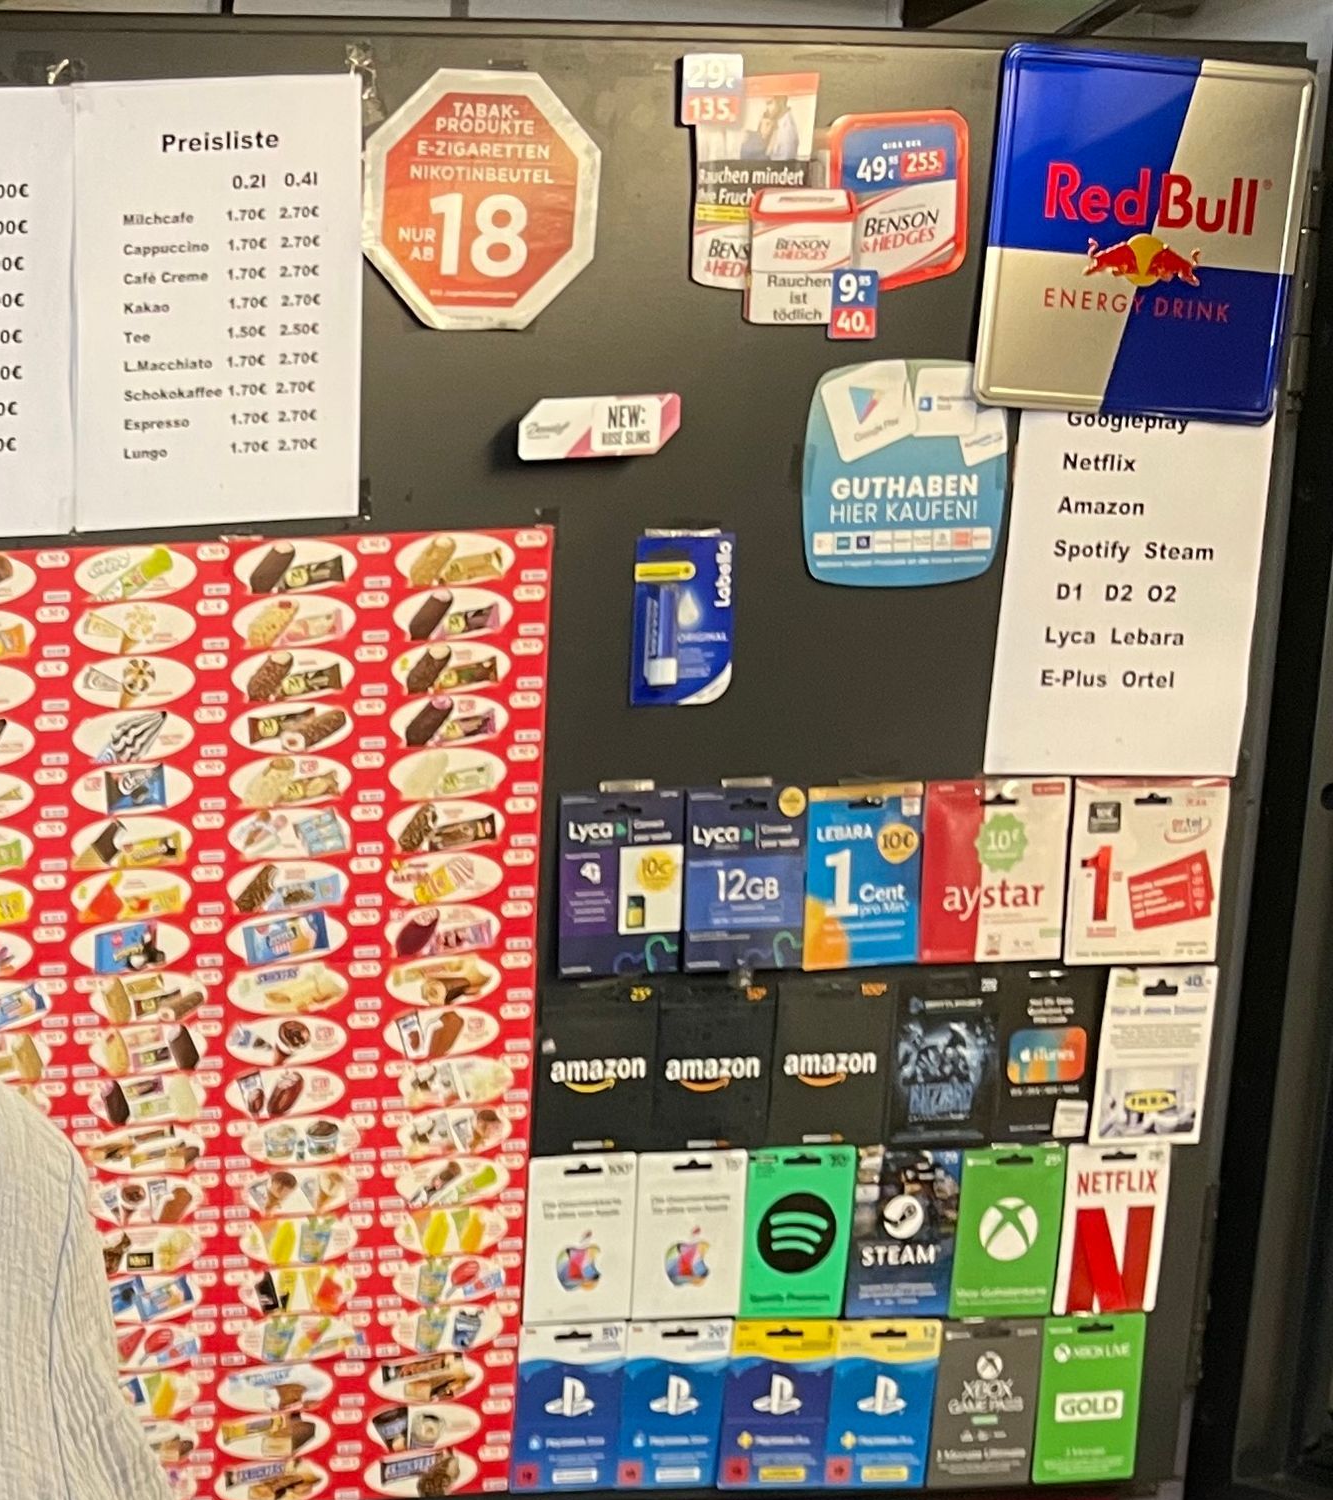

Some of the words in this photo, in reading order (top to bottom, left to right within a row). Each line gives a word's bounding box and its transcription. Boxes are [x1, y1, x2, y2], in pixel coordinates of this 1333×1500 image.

[452, 102, 519, 118] TABAK-
[436, 116, 534, 135] PRODUKTE
[161, 130, 279, 153] Preisliste
[417, 141, 550, 160] E-ZIGARETTEN
[410, 166, 553, 184] NIKOTINBEUTEL
[863, 208, 940, 237] BENSON
[399, 227, 436, 243] NUR
[429, 193, 528, 278] 18
[123, 240, 209, 257] Cappuccino
[228, 238, 267, 252] 1.70€
[281, 235, 320, 249] 2.70€
[410, 247, 435, 261] AB
[767, 273, 832, 290] Rauchen
[123, 301, 169, 314] Kakao
[229, 296, 267, 310] 1.70€
[281, 293, 320, 307] 2.70€
[790, 291, 807, 304] ist
[1044, 287, 1145, 314] ENERGY
[1153, 298, 1230, 323] DRINK
[773, 307, 822, 323] tödlich
[123, 331, 150, 343] Tee
[227, 325, 266, 339] 1.50€
[280, 323, 319, 336] 2.50€
[123, 358, 212, 373] L.Macchiato
[227, 355, 265, 368] 1.70€
[279, 351, 319, 365] 2.70€
[123, 386, 222, 401] Schokokaffee
[228, 383, 267, 397] 1.70€
[276, 380, 315, 394] 2.70€
[123, 417, 189, 431] Espresso
[231, 411, 269, 426] 1.70€
[278, 409, 317, 423] 2.70€
[123, 446, 167, 461] Lungo
[231, 440, 269, 454] 1.70€
[278, 437, 317, 451] 2.70€
[1063, 455, 1136, 473] Netflix
[831, 475, 978, 499] GUTHABEN
[829, 502, 880, 523] HIER
[885, 502, 978, 522] KAUFEN!
[1057, 498, 1144, 516] Amazon
[1053, 541, 1130, 563] Spotify
[1145, 543, 1214, 561] Steam
[1056, 582, 1082, 601] D1
[1105, 584, 1133, 602] D2
[1044, 627, 1095, 648] Lyca
[1110, 628, 1184, 647] Lebara
[1040, 670, 1107, 688] E-Plus
[1122, 670, 1175, 688] Ortel
[568, 820, 614, 844] Lyca
[816, 825, 873, 842] LEBARA
[824, 850, 858, 916] 1
[859, 883, 906, 902] Cent
[551, 1055, 646, 1083] amazon
[1077, 1170, 1157, 1196] NETFLIX
[862, 1245, 936, 1265] STEAM
[1060, 1395, 1118, 1416] GOLD
